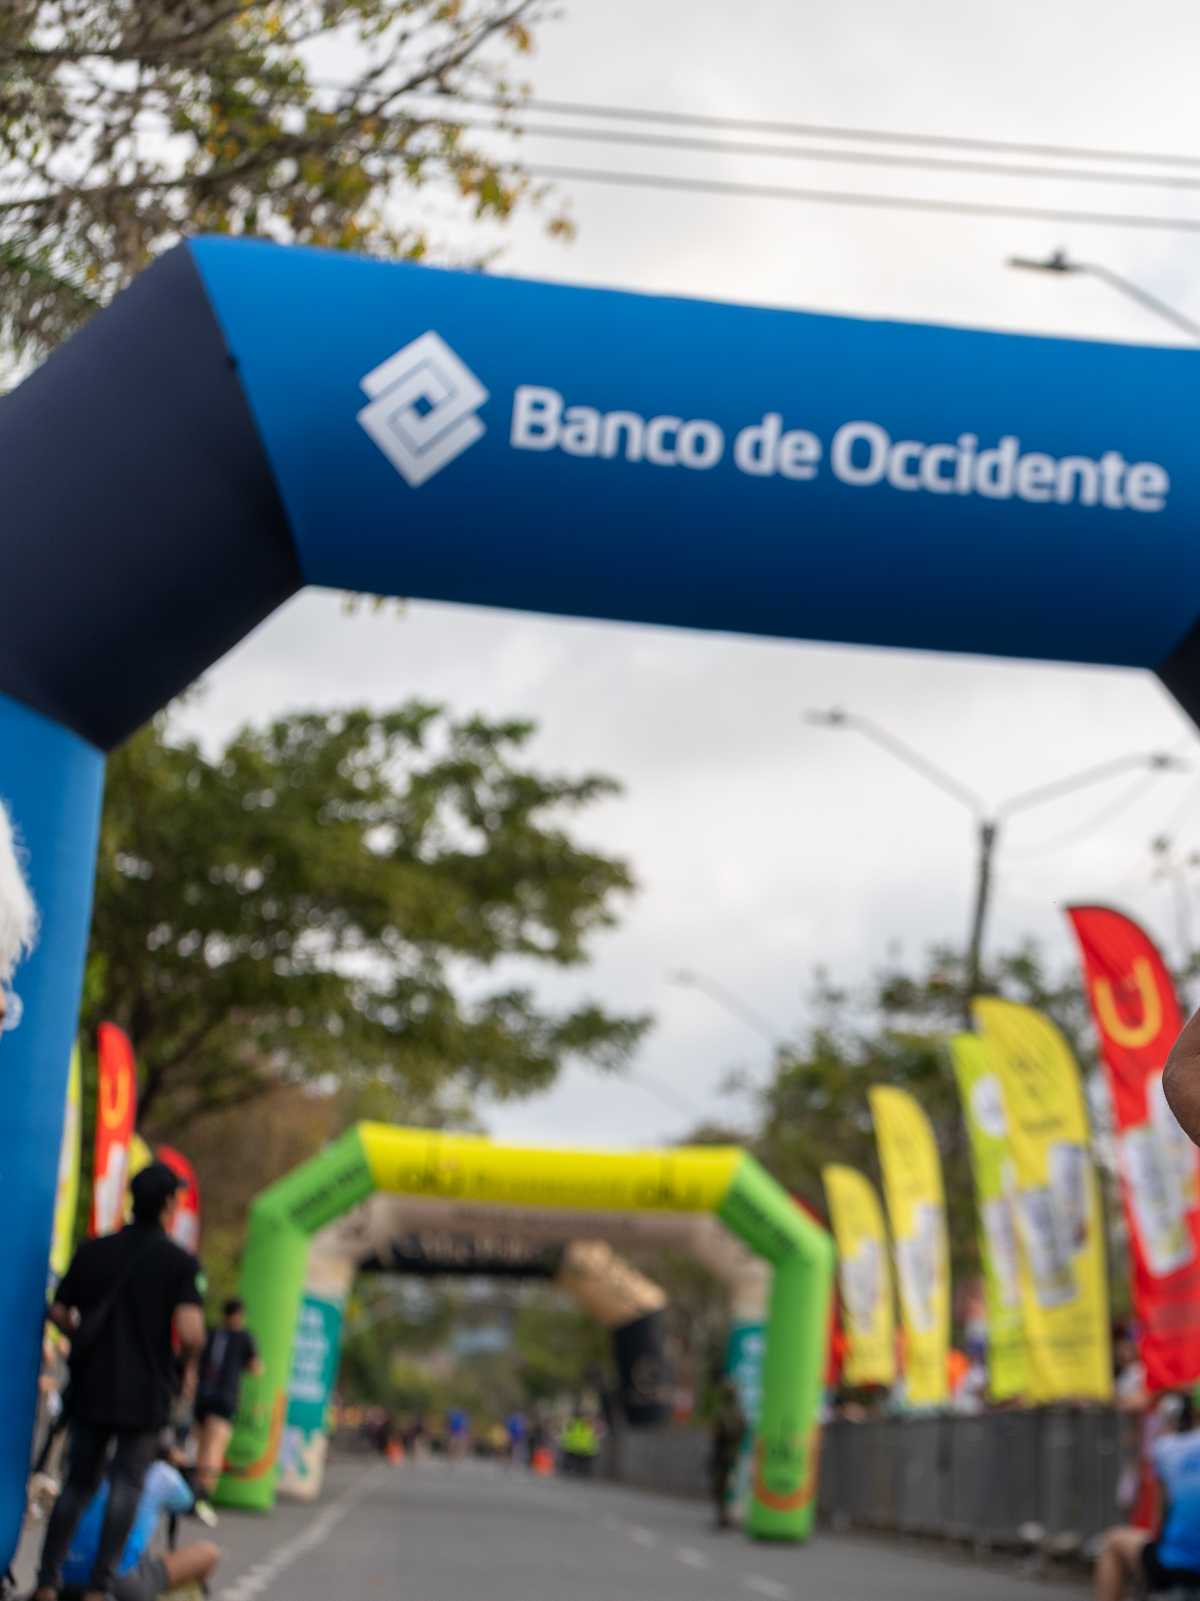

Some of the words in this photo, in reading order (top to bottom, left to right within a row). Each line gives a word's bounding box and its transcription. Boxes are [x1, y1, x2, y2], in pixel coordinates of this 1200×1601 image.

[509, 383, 726, 471] Banco
[732, 411, 822, 481] de
[829, 419, 1171, 514] Occidente
